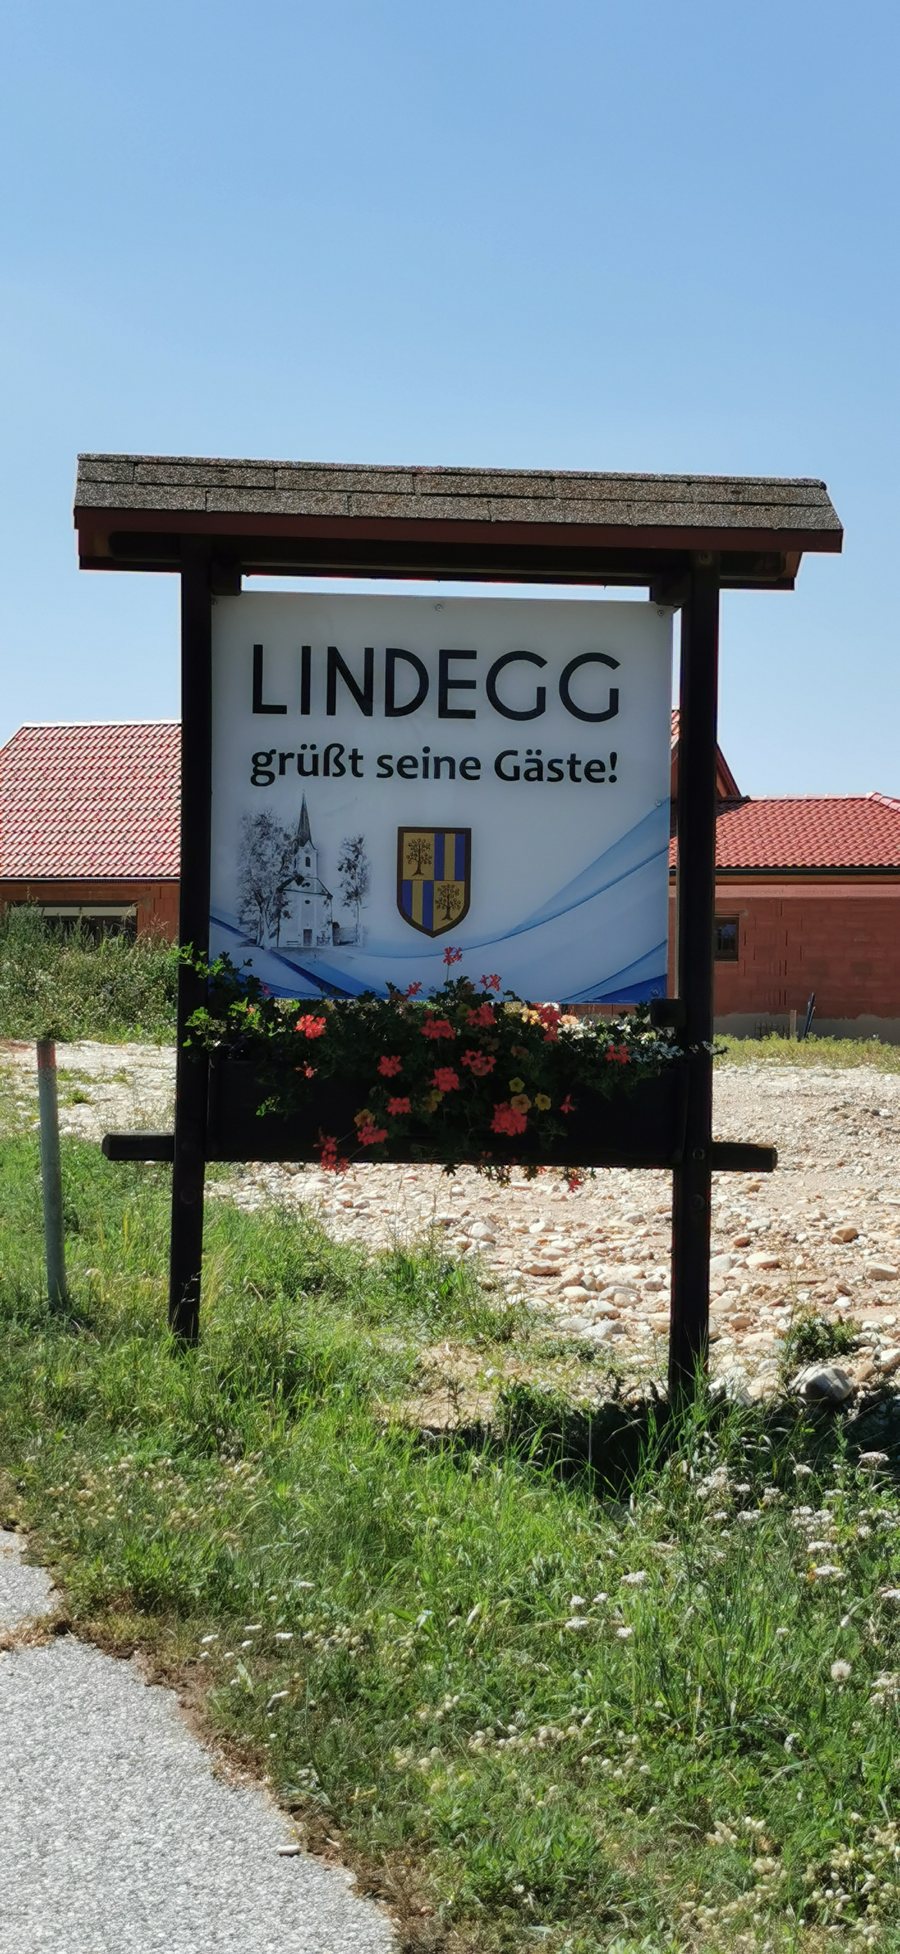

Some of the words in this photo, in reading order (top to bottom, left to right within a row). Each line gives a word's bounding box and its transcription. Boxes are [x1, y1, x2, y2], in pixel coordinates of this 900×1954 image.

[252, 643, 622, 723] LINDEGG
[249, 742, 365, 788] grüßt
[376, 745, 482, 781] seine
[494, 748, 618, 784] Gäste!
